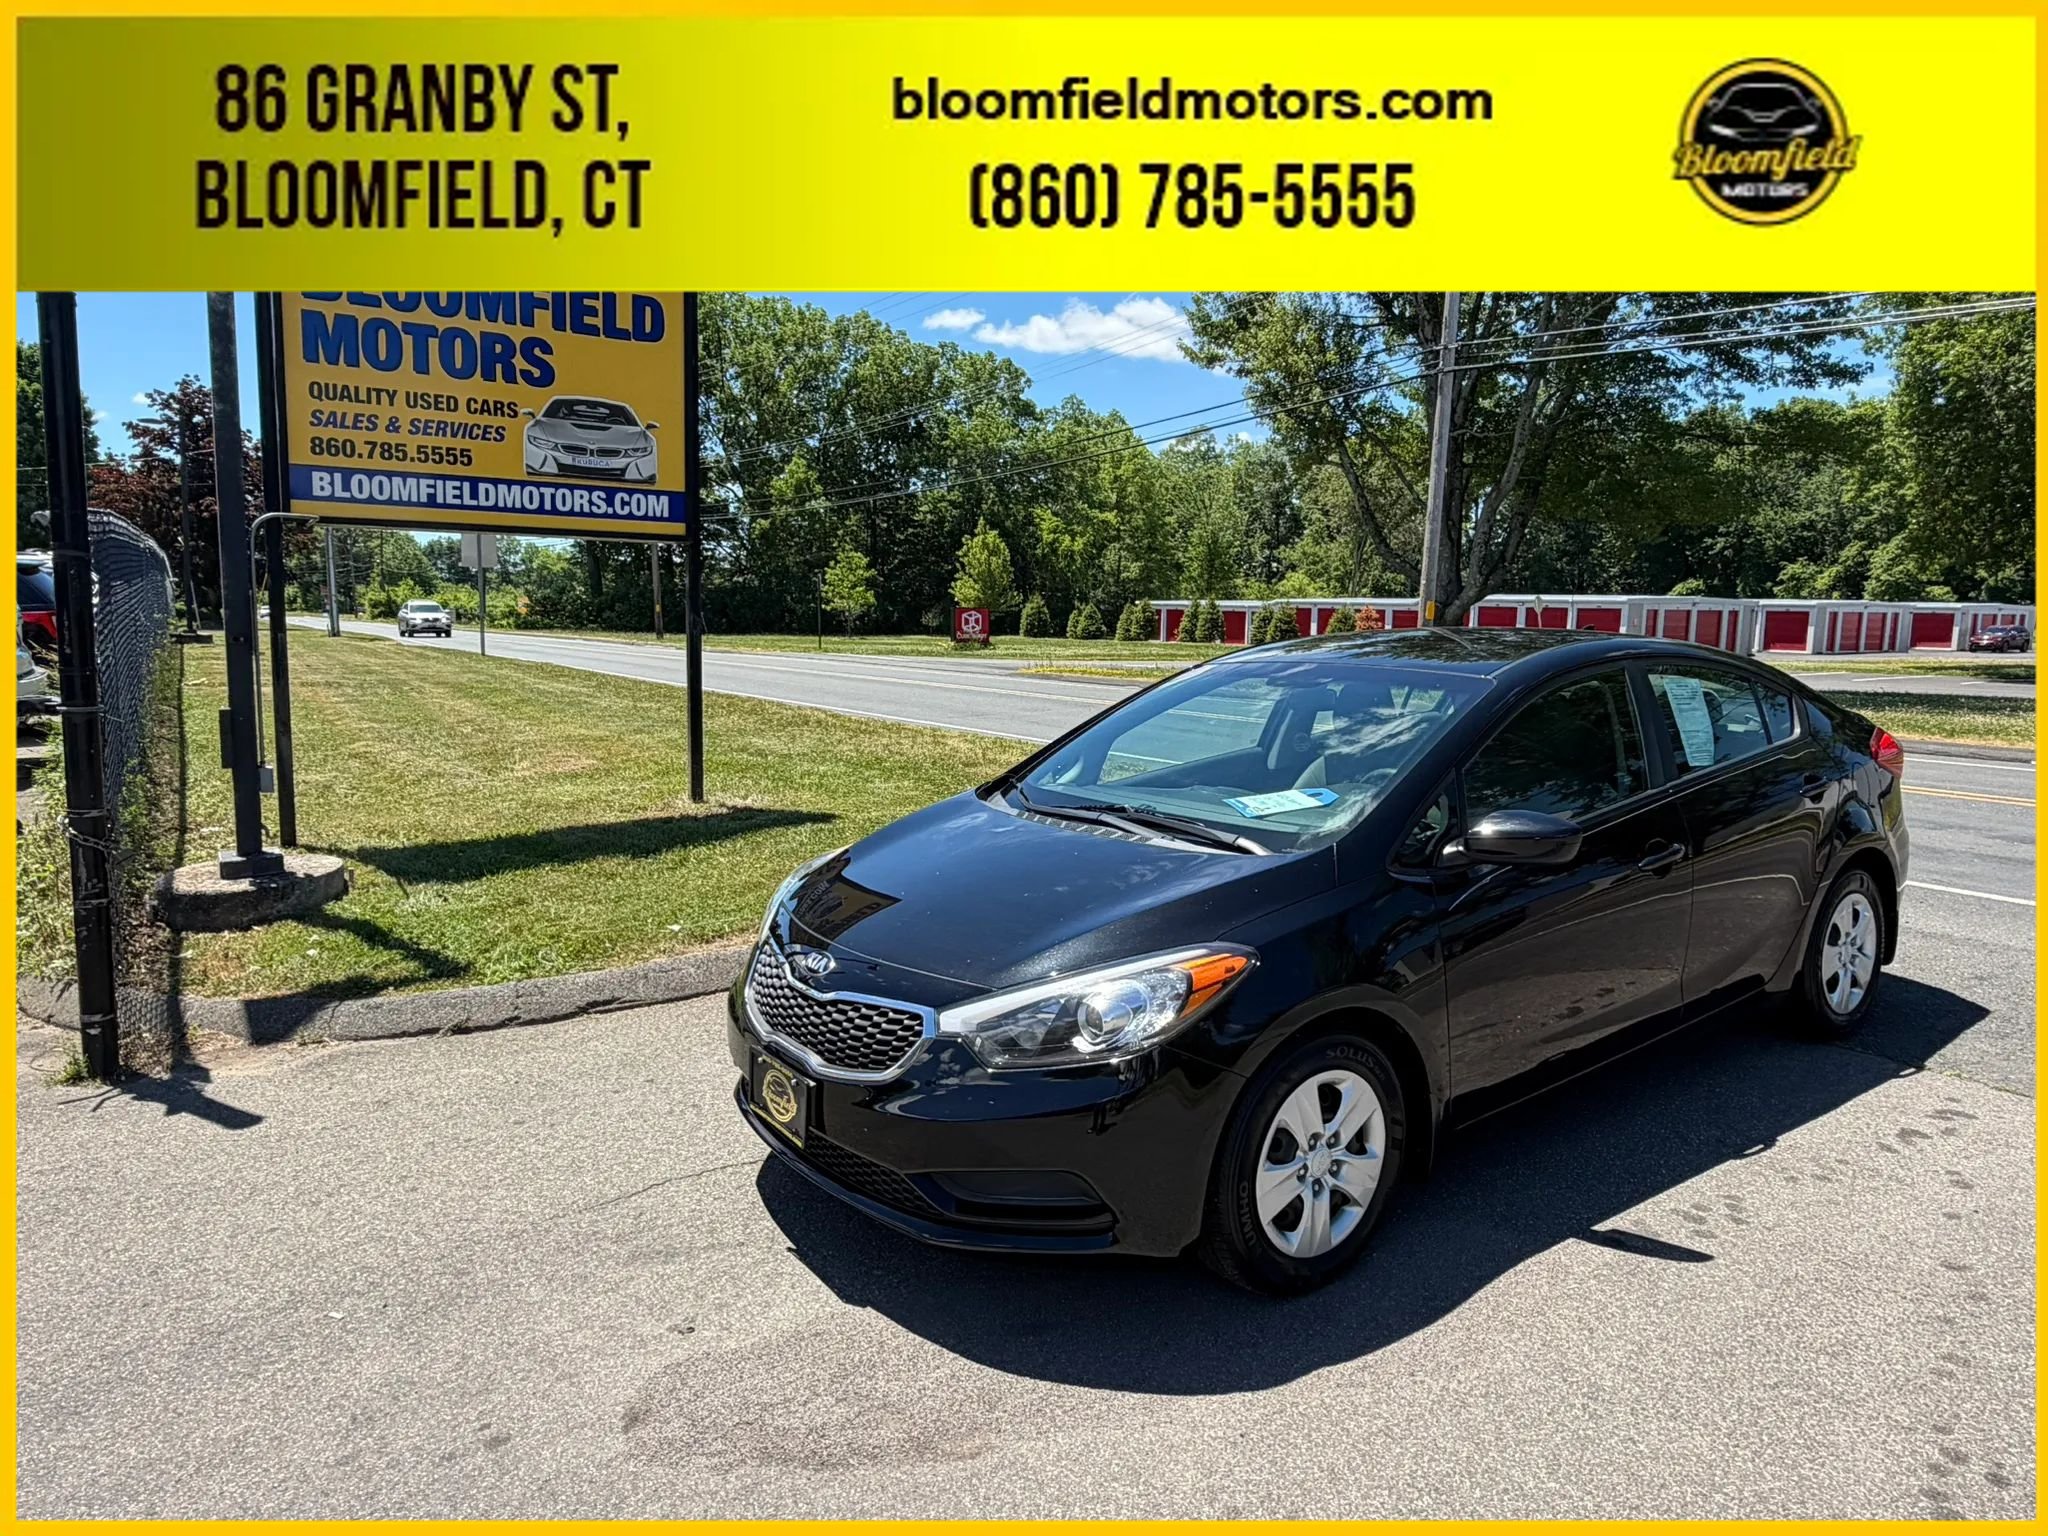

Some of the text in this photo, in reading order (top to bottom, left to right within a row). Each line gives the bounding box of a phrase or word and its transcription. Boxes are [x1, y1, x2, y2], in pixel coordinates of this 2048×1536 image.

[301, 291, 665, 342] OMFIELD
[301, 309, 556, 388] MOTORS
[308, 380, 519, 418] QUALITY USED CARS
[309, 409, 506, 443] SALES & SERVICES
[309, 436, 473, 467] 860.785.5555
[311, 471, 669, 518] BLOOMFIELDMOTORS.COM
[807, 952, 828, 972] KIA
[1325, 1046, 1374, 1068] SOLUS
